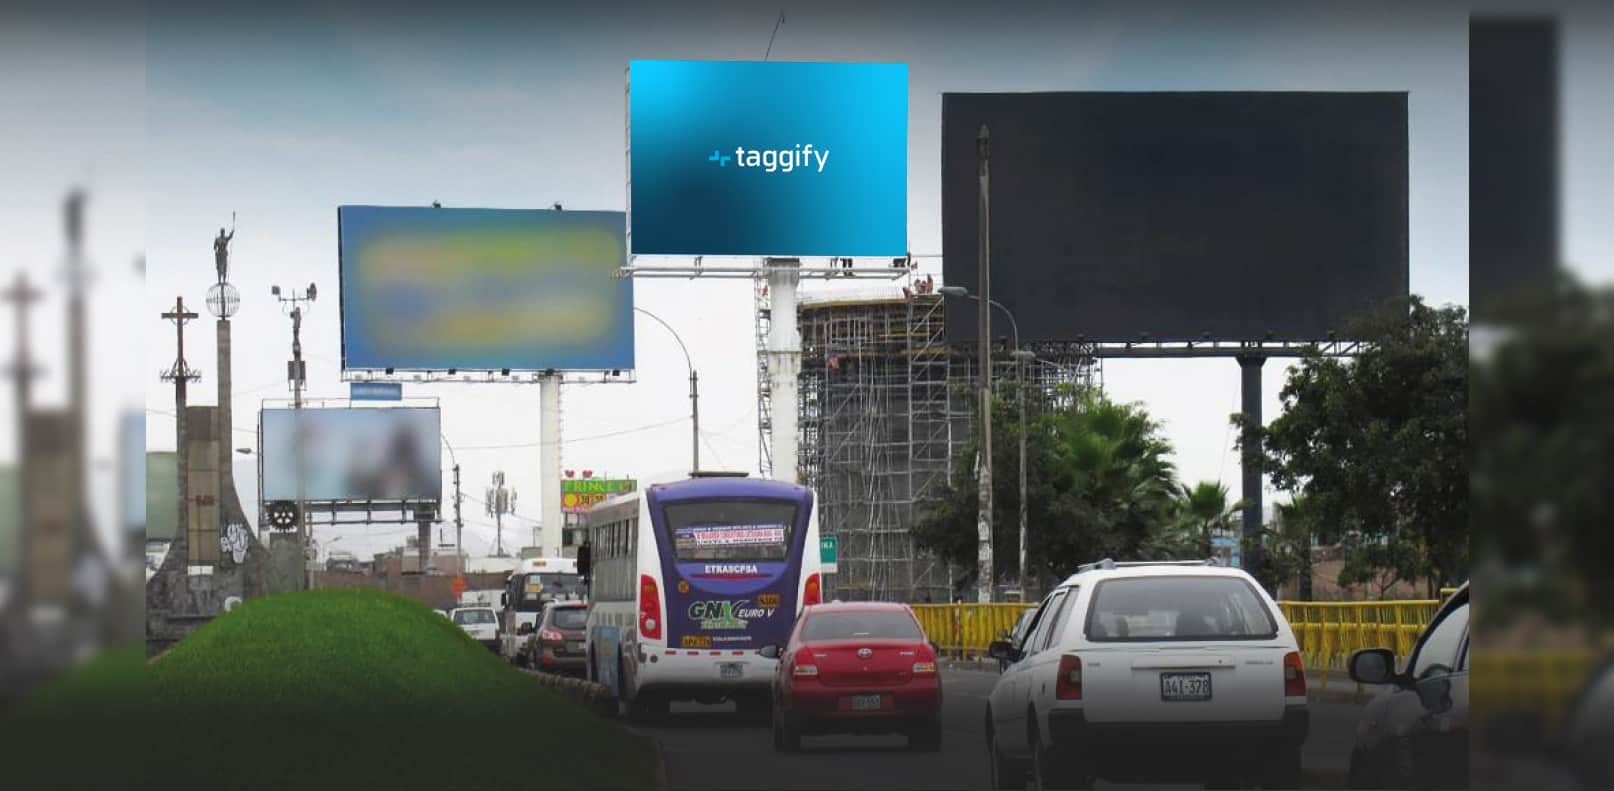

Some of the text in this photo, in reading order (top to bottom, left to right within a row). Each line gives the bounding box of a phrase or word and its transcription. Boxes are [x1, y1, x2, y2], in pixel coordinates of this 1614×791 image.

[736, 144, 829, 172] taggify
[738, 608, 764, 618] EURO
[767, 608, 775, 618] V
[1164, 679, 1209, 695] A41-378
